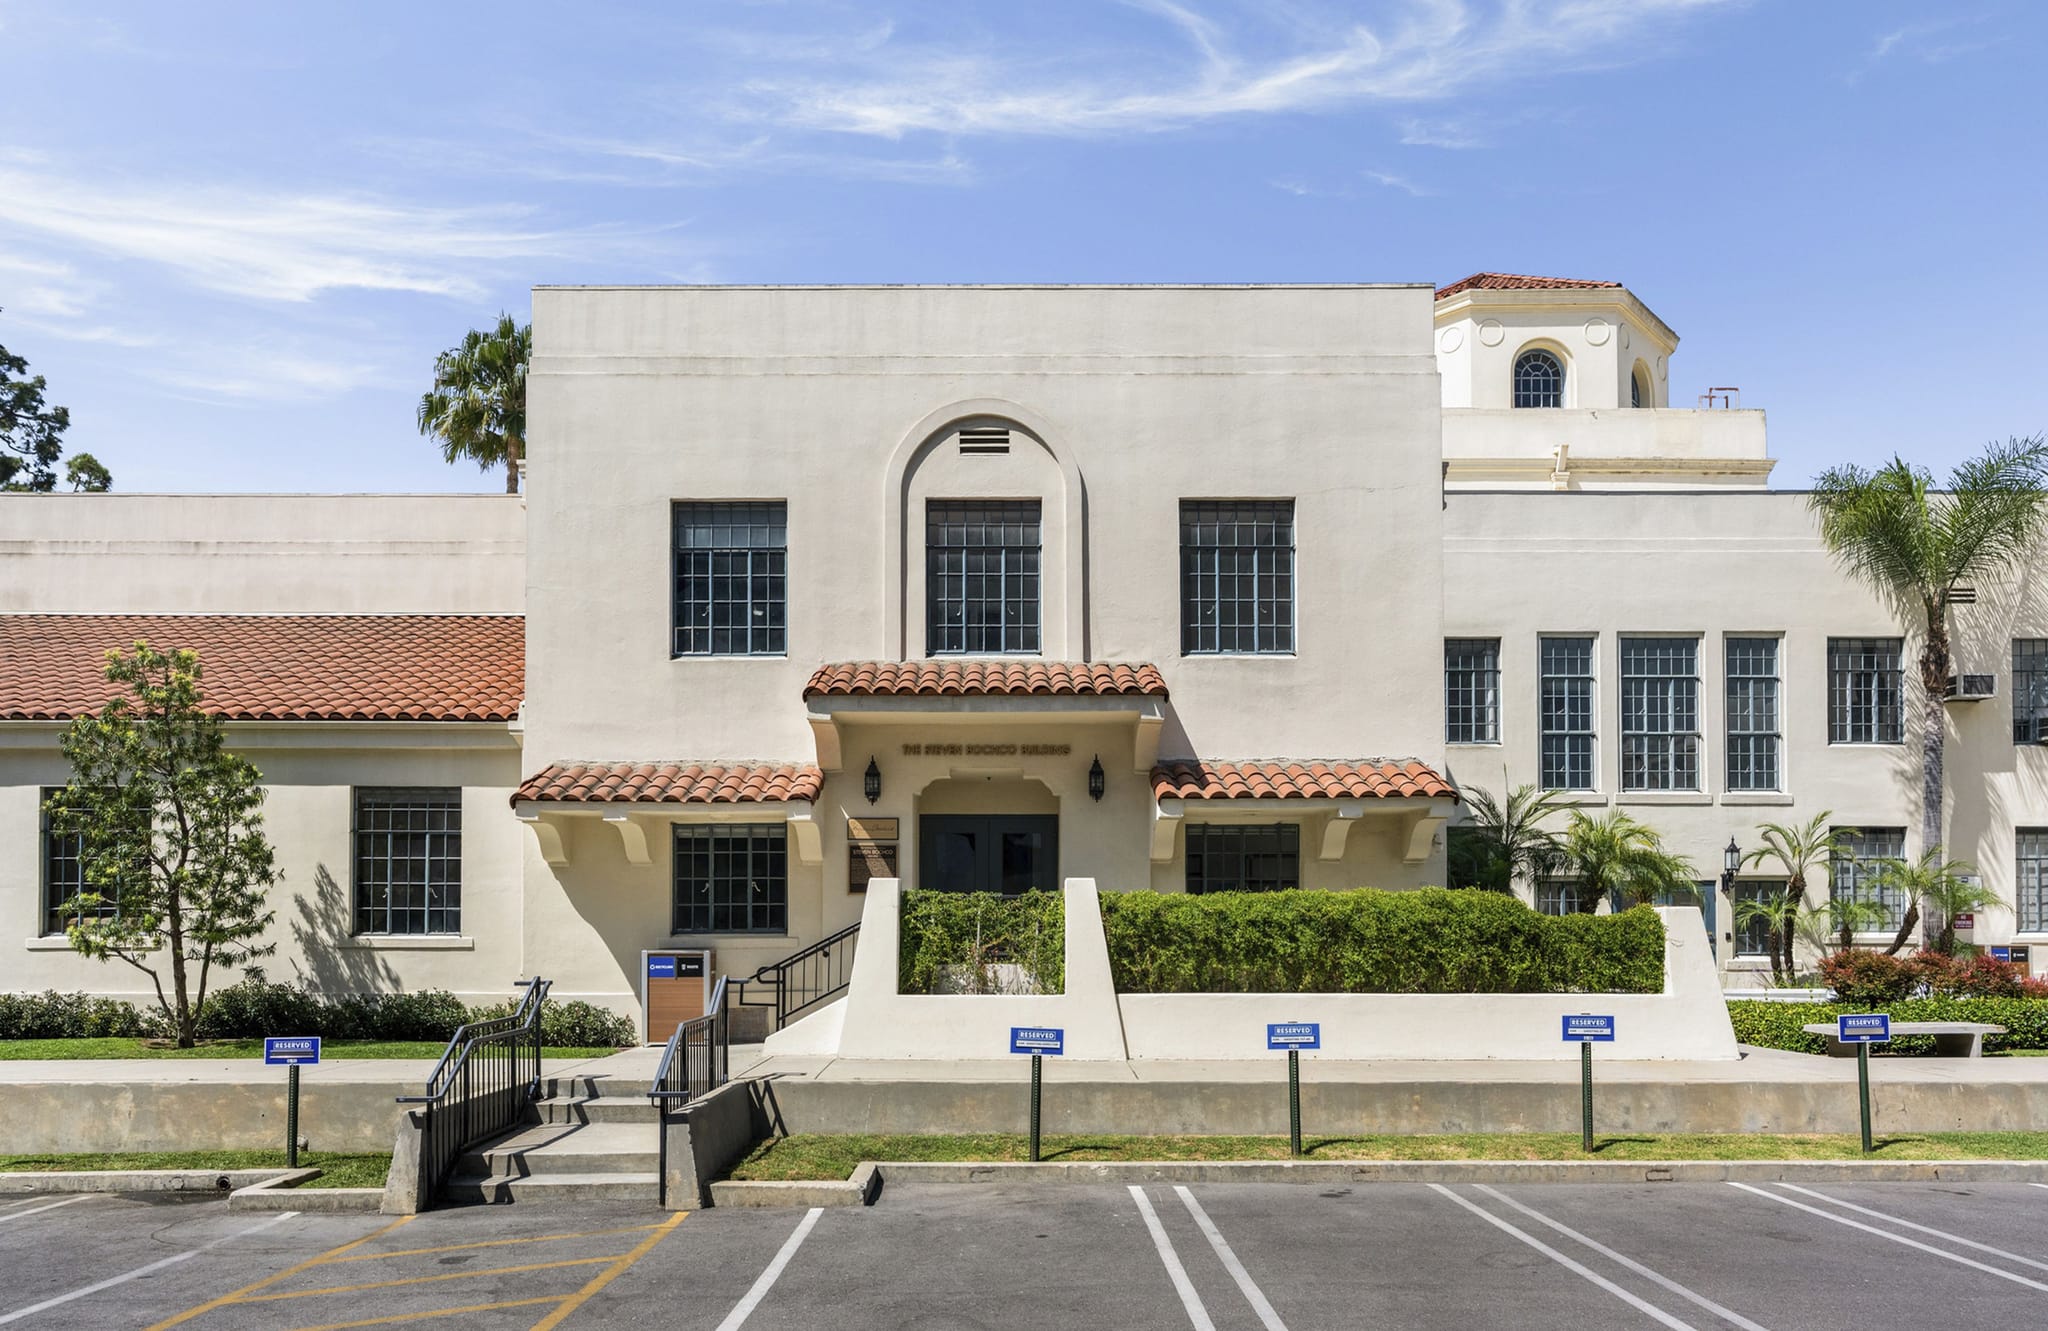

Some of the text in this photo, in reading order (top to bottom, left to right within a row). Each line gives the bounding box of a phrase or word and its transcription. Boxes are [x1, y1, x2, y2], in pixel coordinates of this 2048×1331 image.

[902, 743, 1072, 756] THE STEVEN BOCHCO BUILDING
[1848, 1018, 1880, 1026] RESERVED
